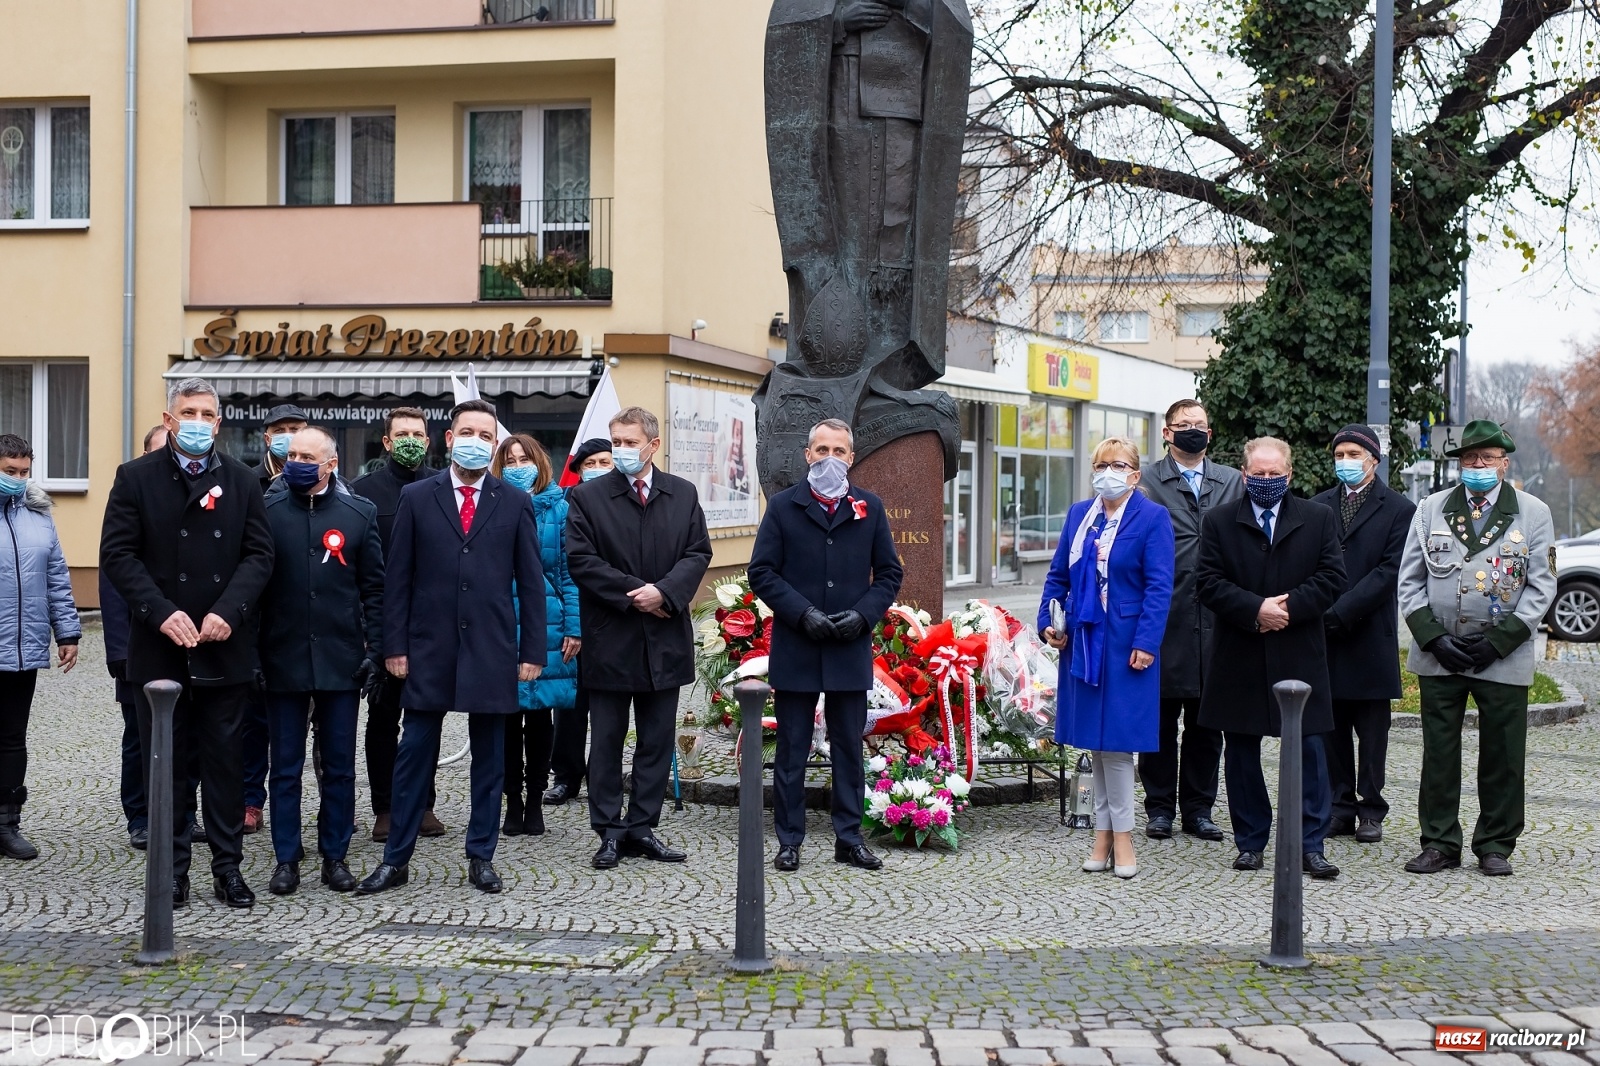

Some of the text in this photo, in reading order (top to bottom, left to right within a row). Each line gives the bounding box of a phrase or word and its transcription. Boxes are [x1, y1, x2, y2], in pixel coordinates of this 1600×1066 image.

[194, 308, 578, 357] Świat Prezentów
[225, 404, 270, 420] On-Lin
[885, 508, 911, 519] KUP
[891, 531, 930, 544] LIKS
